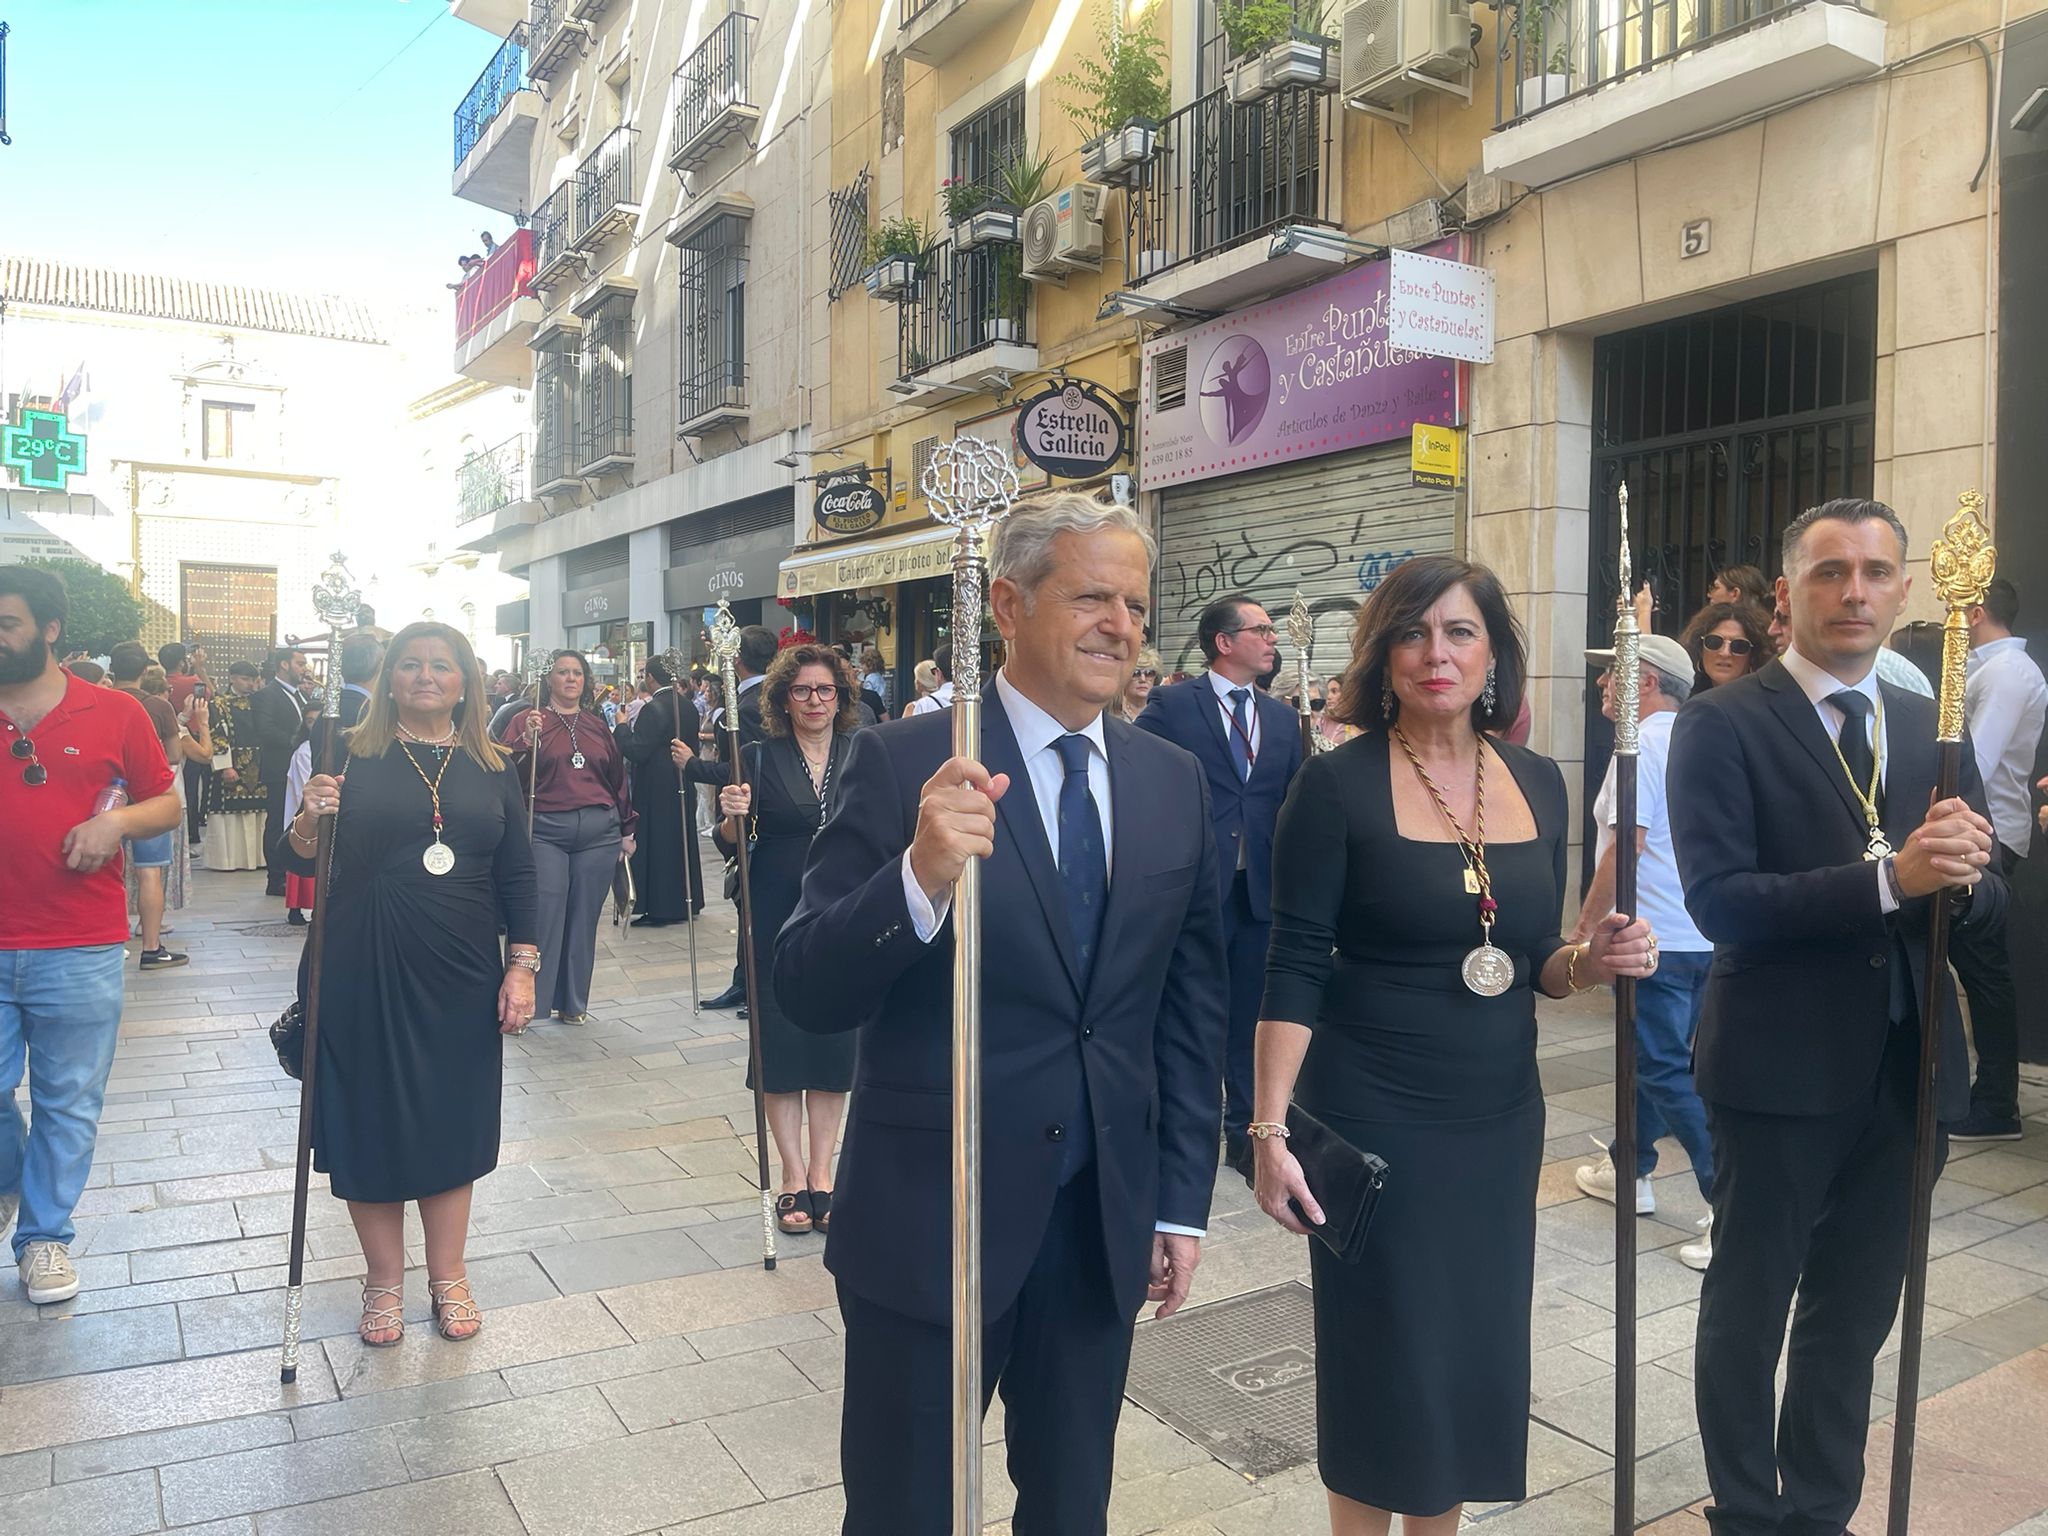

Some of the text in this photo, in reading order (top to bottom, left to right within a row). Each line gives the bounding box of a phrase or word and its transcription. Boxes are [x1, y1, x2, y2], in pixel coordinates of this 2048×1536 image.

[1685, 223, 1703, 255] 5
[1399, 280, 1476, 310] Entre Puntas
[1323, 290, 1390, 346] Punta
[1398, 310, 1480, 341] y Castañuelas
[1279, 338, 1434, 405] y Castañue
[1036, 407, 1109, 434] Estrella
[1333, 406, 1346, 425] de
[1350, 403, 1388, 420] Danza
[1039, 430, 1105, 456] Galicia
[1428, 440, 1451, 453] InPost
[1151, 454, 1164, 466] 639
[1165, 451, 1173, 463] 02
[1175, 449, 1183, 461] 18
[1416, 475, 1452, 487] Punto Pack
[708, 570, 744, 593] GINOS
[839, 565, 874, 583] Taberna
[584, 596, 608, 615] GINOS
